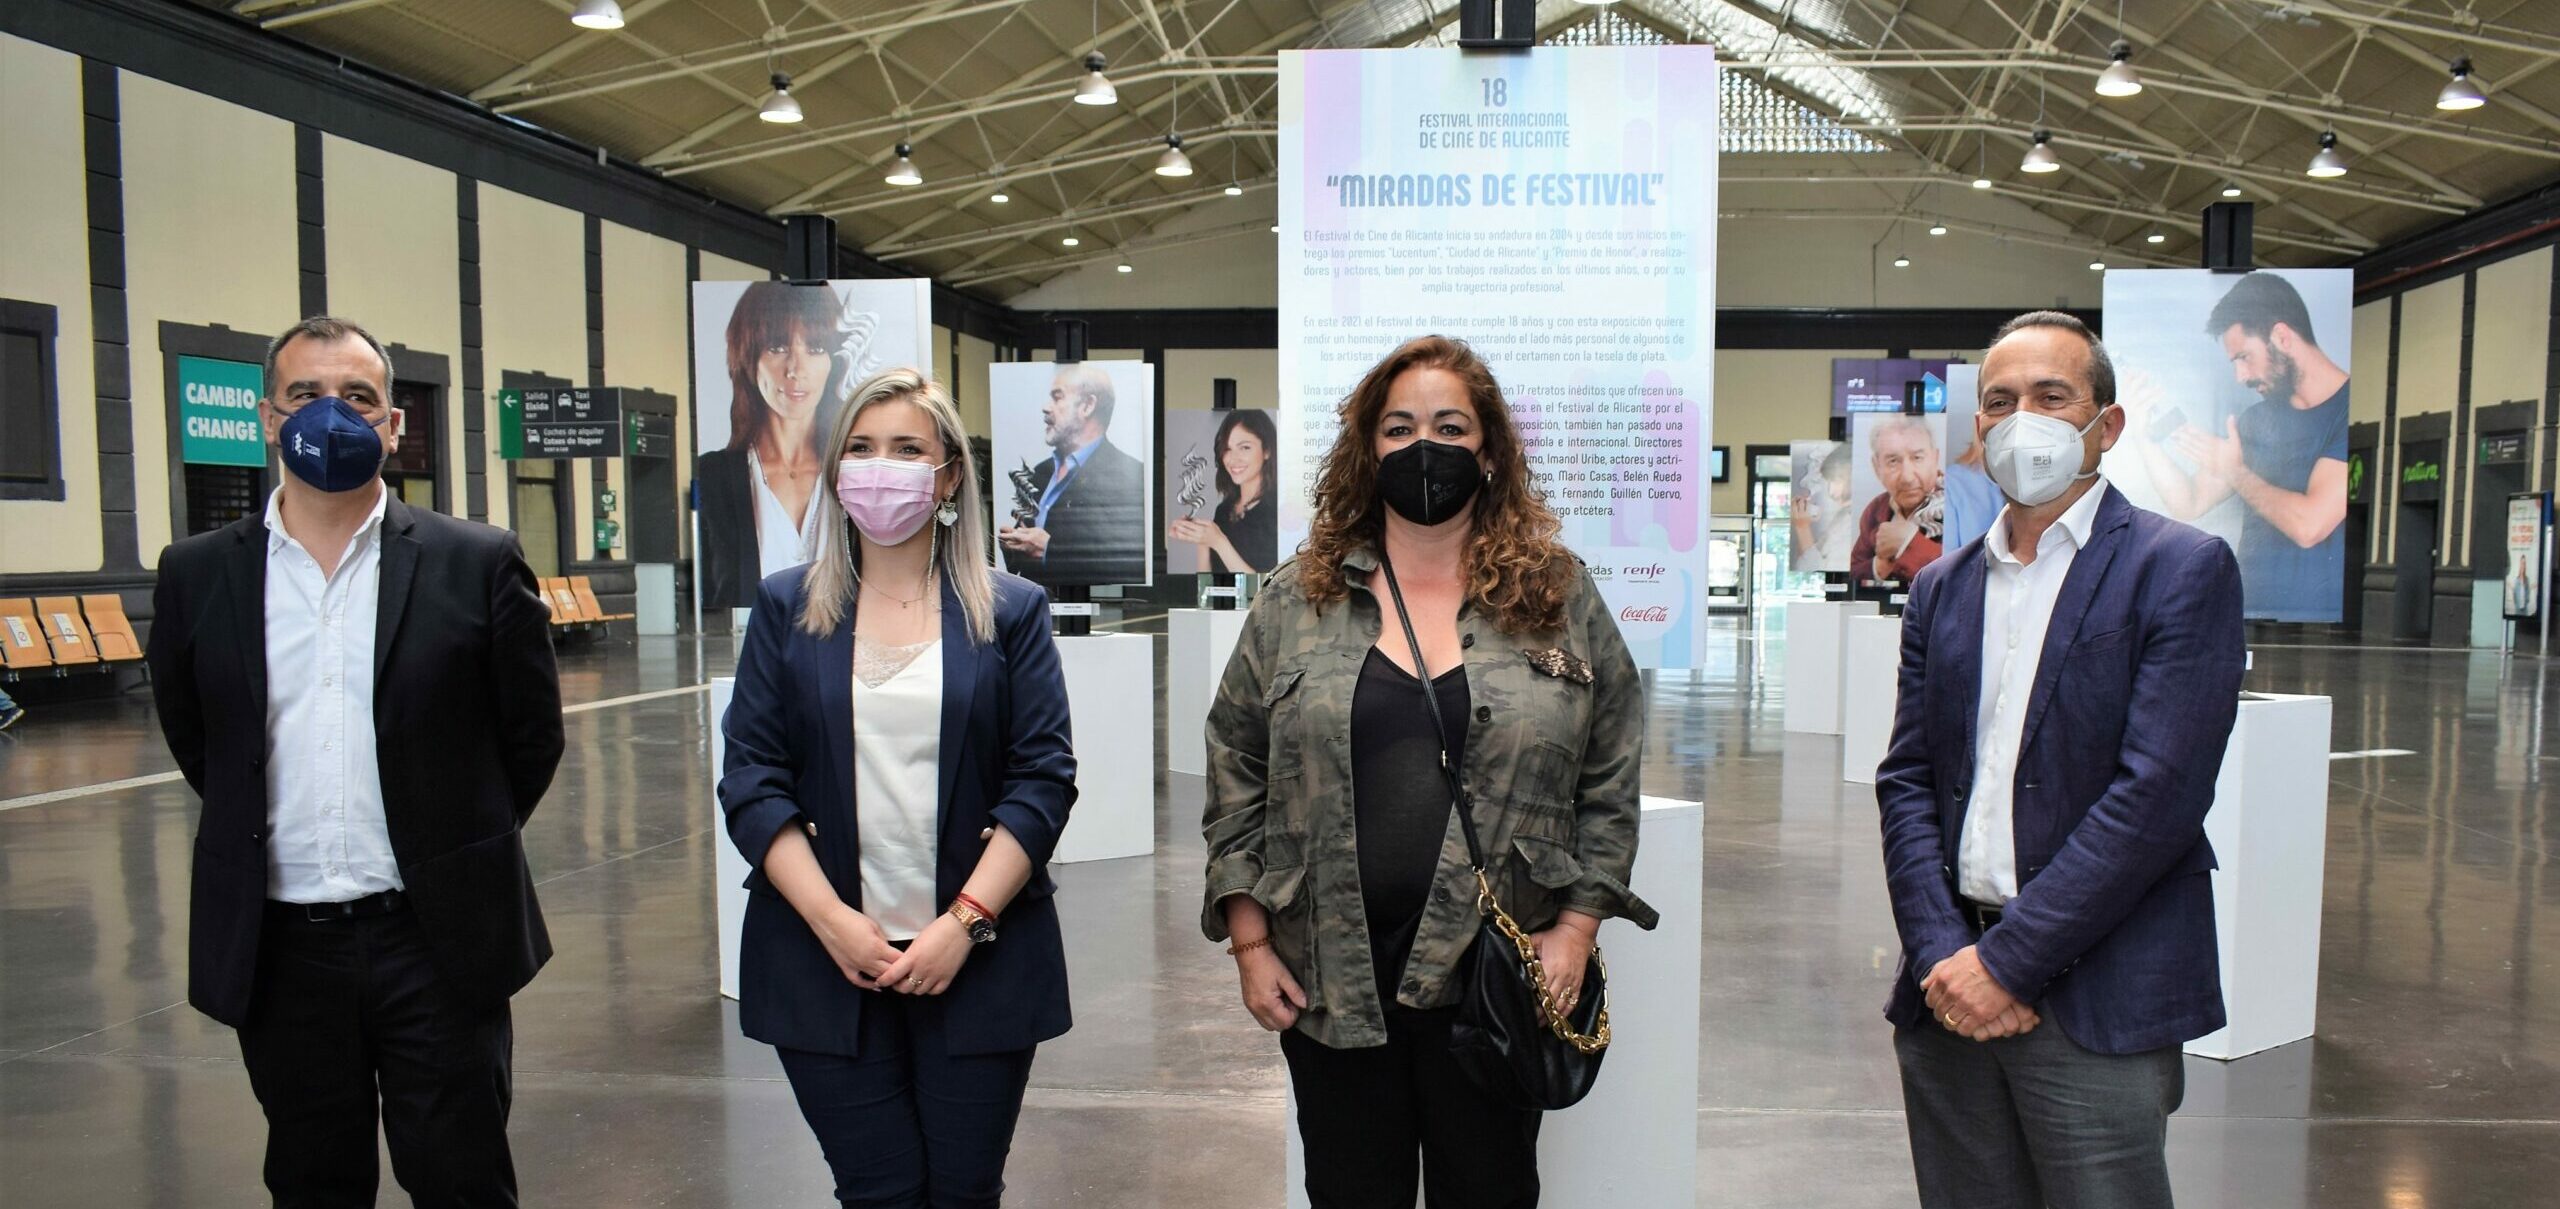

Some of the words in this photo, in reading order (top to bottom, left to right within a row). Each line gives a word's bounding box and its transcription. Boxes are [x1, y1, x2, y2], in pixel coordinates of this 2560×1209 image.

[1481, 77, 1507, 107] 18
[1419, 112, 1473, 128] FESTIVAL
[1477, 112, 1570, 128] INTERNACIONAL
[1419, 131, 1437, 149] DE
[1442, 131, 1475, 149] CINE
[1479, 131, 1497, 149] DE
[1502, 131, 1570, 149] ALICANTE
[1326, 173, 1471, 207] “MIRADAS
[1482, 173, 1516, 207] DE
[1526, 173, 1664, 207] FESTIVAL”
[1304, 230, 1311, 241] El
[1315, 230, 1350, 241] Festival
[1354, 230, 1365, 241] de
[1368, 230, 1388, 241] Cine
[1391, 230, 1402, 241] de
[1405, 230, 1443, 241] Alicante
[1446, 230, 1470, 241] inicia
[1473, 232, 1485, 241] su
[1488, 230, 1532, 241] andadura
[1535, 232, 1546, 241] en
[1576, 232, 1582, 243] y
[1585, 230, 1613, 241] desde
[1617, 232, 1633, 241] sus
[1637, 230, 1667, 241] inicios
[1304, 247, 1328, 261] trega
[1331, 247, 1345, 258] los
[1348, 247, 1385, 261] premios
[1483, 247, 1494, 258] de
[1543, 250, 1549, 261] y
[1591, 247, 1602, 258] de
[1304, 264, 1329, 276] dores
[1333, 267, 1339, 278] y
[1384, 264, 1404, 276] bien
[1408, 267, 1424, 278] por
[1428, 264, 1442, 276] los
[1446, 264, 1484, 278] trabajos
[1489, 264, 1537, 276] realizados
[1541, 267, 1552, 276] en
[1557, 264, 1571, 276] los
[1643, 267, 1649, 276] o
[1654, 267, 1669, 278] por
[1673, 267, 1686, 276] su
[1421, 281, 1452, 295] amplia
[1456, 281, 1507, 295] trayectoria
[1304, 316, 1314, 327] En
[1318, 316, 1338, 327] este
[1365, 316, 1373, 327] el
[1376, 316, 1412, 327] Festival
[1415, 316, 1426, 327] de
[1430, 316, 1468, 327] Alicante
[1471, 316, 1505, 329] cumple
[1509, 316, 1518, 327] 18
[1521, 316, 1544, 327] años
[1548, 318, 1553, 329] y
[1557, 318, 1574, 327] con
[1577, 316, 1598, 327] esta
[1601, 316, 1651, 329] exposición
[1655, 316, 1684, 329] quiere
[1304, 334, 1330, 344] rendir
[1333, 336, 1344, 344] un
[1348, 334, 1392, 347] homenaje
[1466, 334, 1516, 344] mostrando
[1519, 334, 1527, 344] el
[1530, 334, 1550, 344] lado
[1553, 334, 1573, 344] más
[1576, 334, 1615, 347] personal
[1619, 334, 1630, 344] de
[1633, 334, 1669, 347] algunos
[1673, 334, 1684, 344] de
[1320, 351, 1333, 361] los
[1337, 351, 1373, 361] artistas
[1490, 353, 1501, 361] en
[1505, 351, 1512, 361] el
[1516, 351, 1560, 361] certamen
[1563, 353, 1580, 361] con
[1583, 351, 1592, 361] la
[1595, 351, 1623, 361] tesela
[1626, 351, 1638, 361] de
[186, 382, 256, 410] CAMBIO
[525, 391, 548, 400] Salida
[575, 391, 589, 399] Taxi
[1304, 384, 1320, 396] Una
[1323, 384, 1345, 396] serie
[1517, 384, 1525, 396] 17
[1527, 384, 1565, 396] retratos
[1568, 384, 1605, 396] inéditos
[1608, 387, 1625, 398] que
[1628, 384, 1663, 396] ofrecen
[1666, 387, 1683, 396] una
[525, 402, 549, 411] Eixida
[575, 401, 590, 410] Taxi
[1304, 402, 1331, 413] visión
[1530, 404, 1542, 413] en
[1546, 402, 1554, 413] el
[1558, 402, 1594, 413] Festival
[1598, 402, 1609, 413] de
[1613, 402, 1652, 413] Alicante
[1655, 404, 1671, 415] por
[1674, 402, 1683, 413] el
[187, 416, 258, 442] CHANGE
[578, 427, 604, 437] alquiler
[1303, 422, 1321, 432] que
[1565, 420, 1602, 430] también
[1606, 420, 1624, 430] han
[1628, 420, 1661, 432] pasado
[1666, 422, 1683, 430] una
[543, 437, 566, 445] Cotxes
[567, 437, 576, 445] de
[578, 437, 602, 447] lloguer
[1304, 437, 1333, 449] amplia
[1558, 439, 1563, 447] e
[1568, 437, 1631, 447] internacional.
[1634, 437, 1683, 447] Directores
[1547, 454, 1579, 464] Imanol
[1582, 454, 1607, 466] Uribe,
[1609, 454, 1645, 464] actores
[1648, 456, 1654, 467] y
[1656, 454, 1685, 464] actri-
[1559, 471, 1585, 481] Mario
[1589, 471, 1620, 483] Casas,
[1623, 471, 1649, 481] Belén
[1653, 471, 1682, 481] Rueda
[1562, 488, 1605, 499] Fernando
[1610, 488, 1642, 499] Guillén
[1648, 488, 1682, 500] Cuervo,
[1623, 563, 1665, 579] renfe
